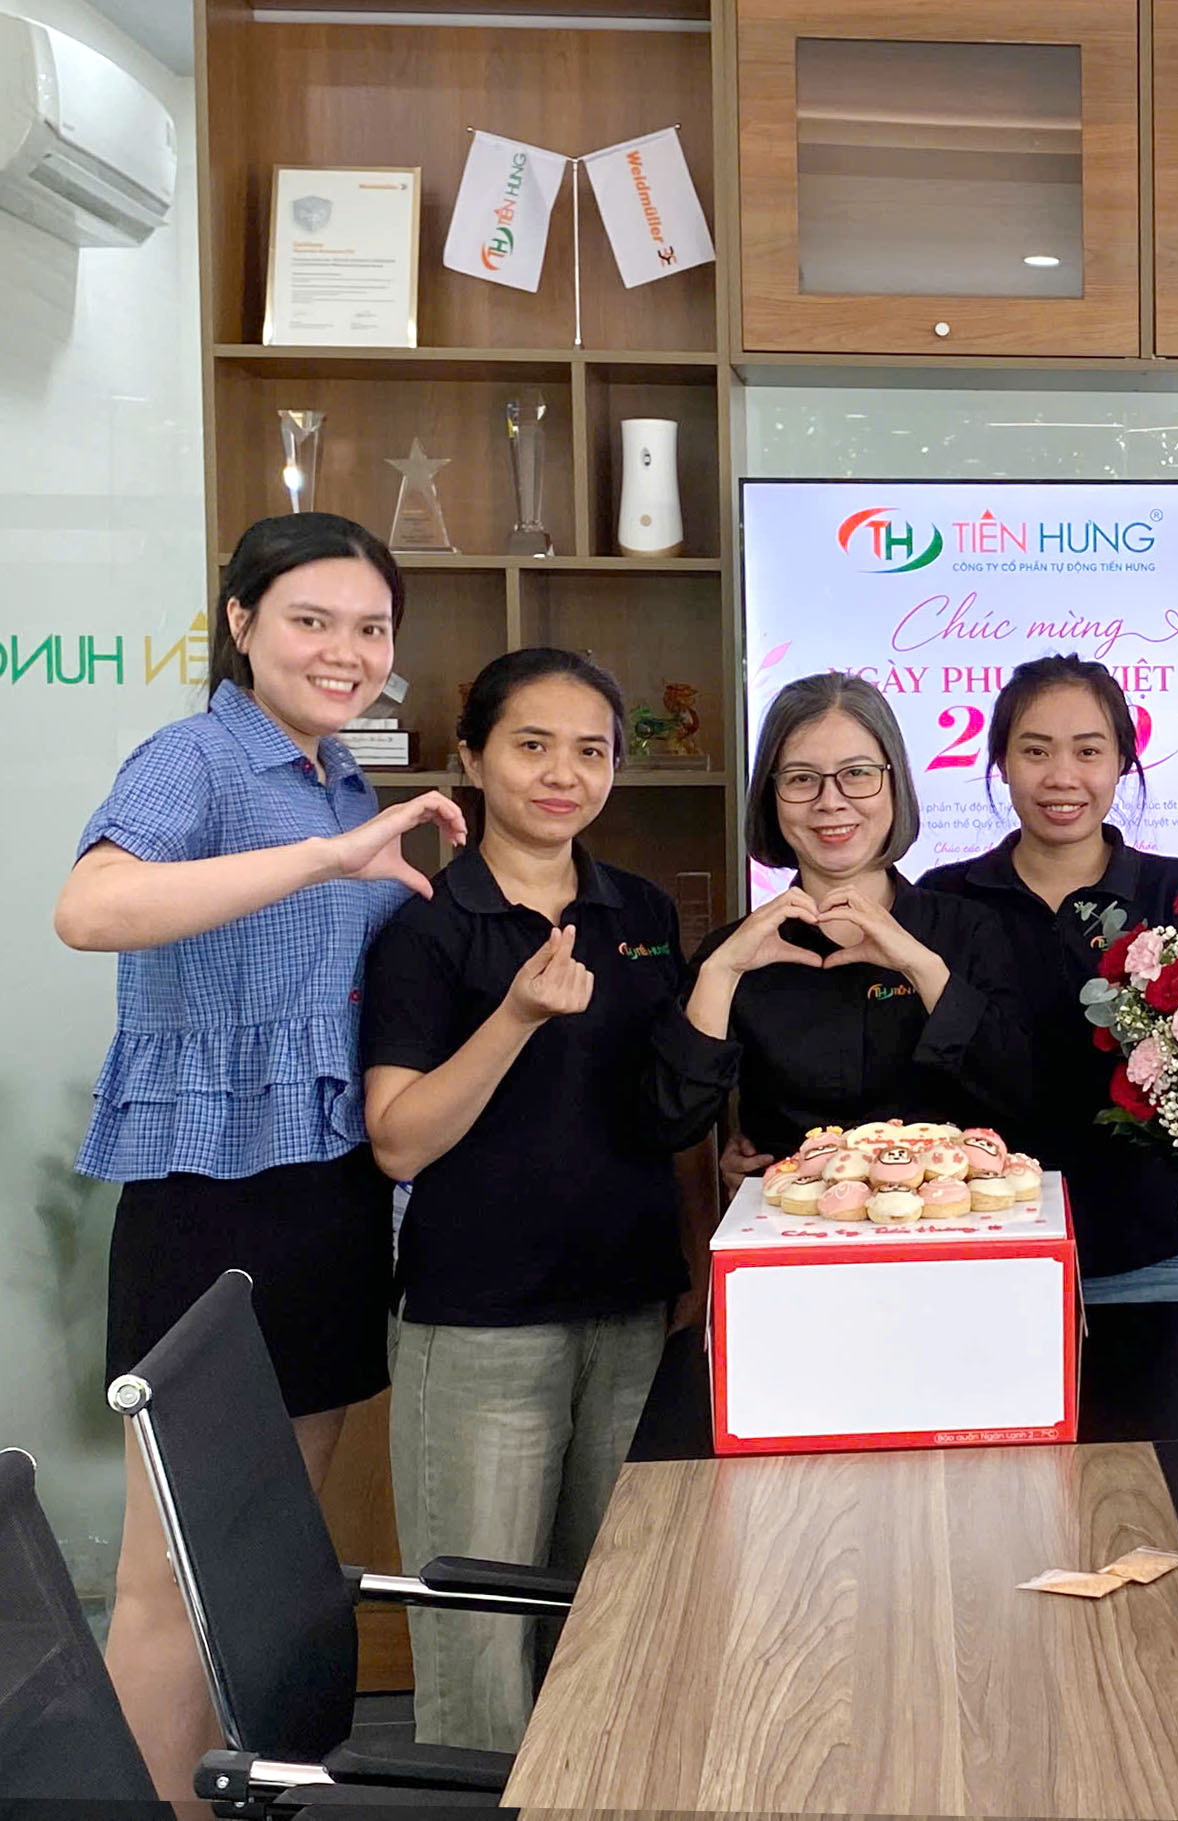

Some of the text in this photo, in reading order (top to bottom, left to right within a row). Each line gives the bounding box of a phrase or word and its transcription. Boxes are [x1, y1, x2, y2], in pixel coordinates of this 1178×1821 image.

[626, 150, 664, 243] Weidmüller
[953, 562, 983, 572] CÔNG
[986, 563, 998, 571] TY
[1001, 559, 1016, 572] CỔ
[1067, 561, 1097, 573] ĐỘNG
[891, 591, 1124, 660] Chúc mừng
